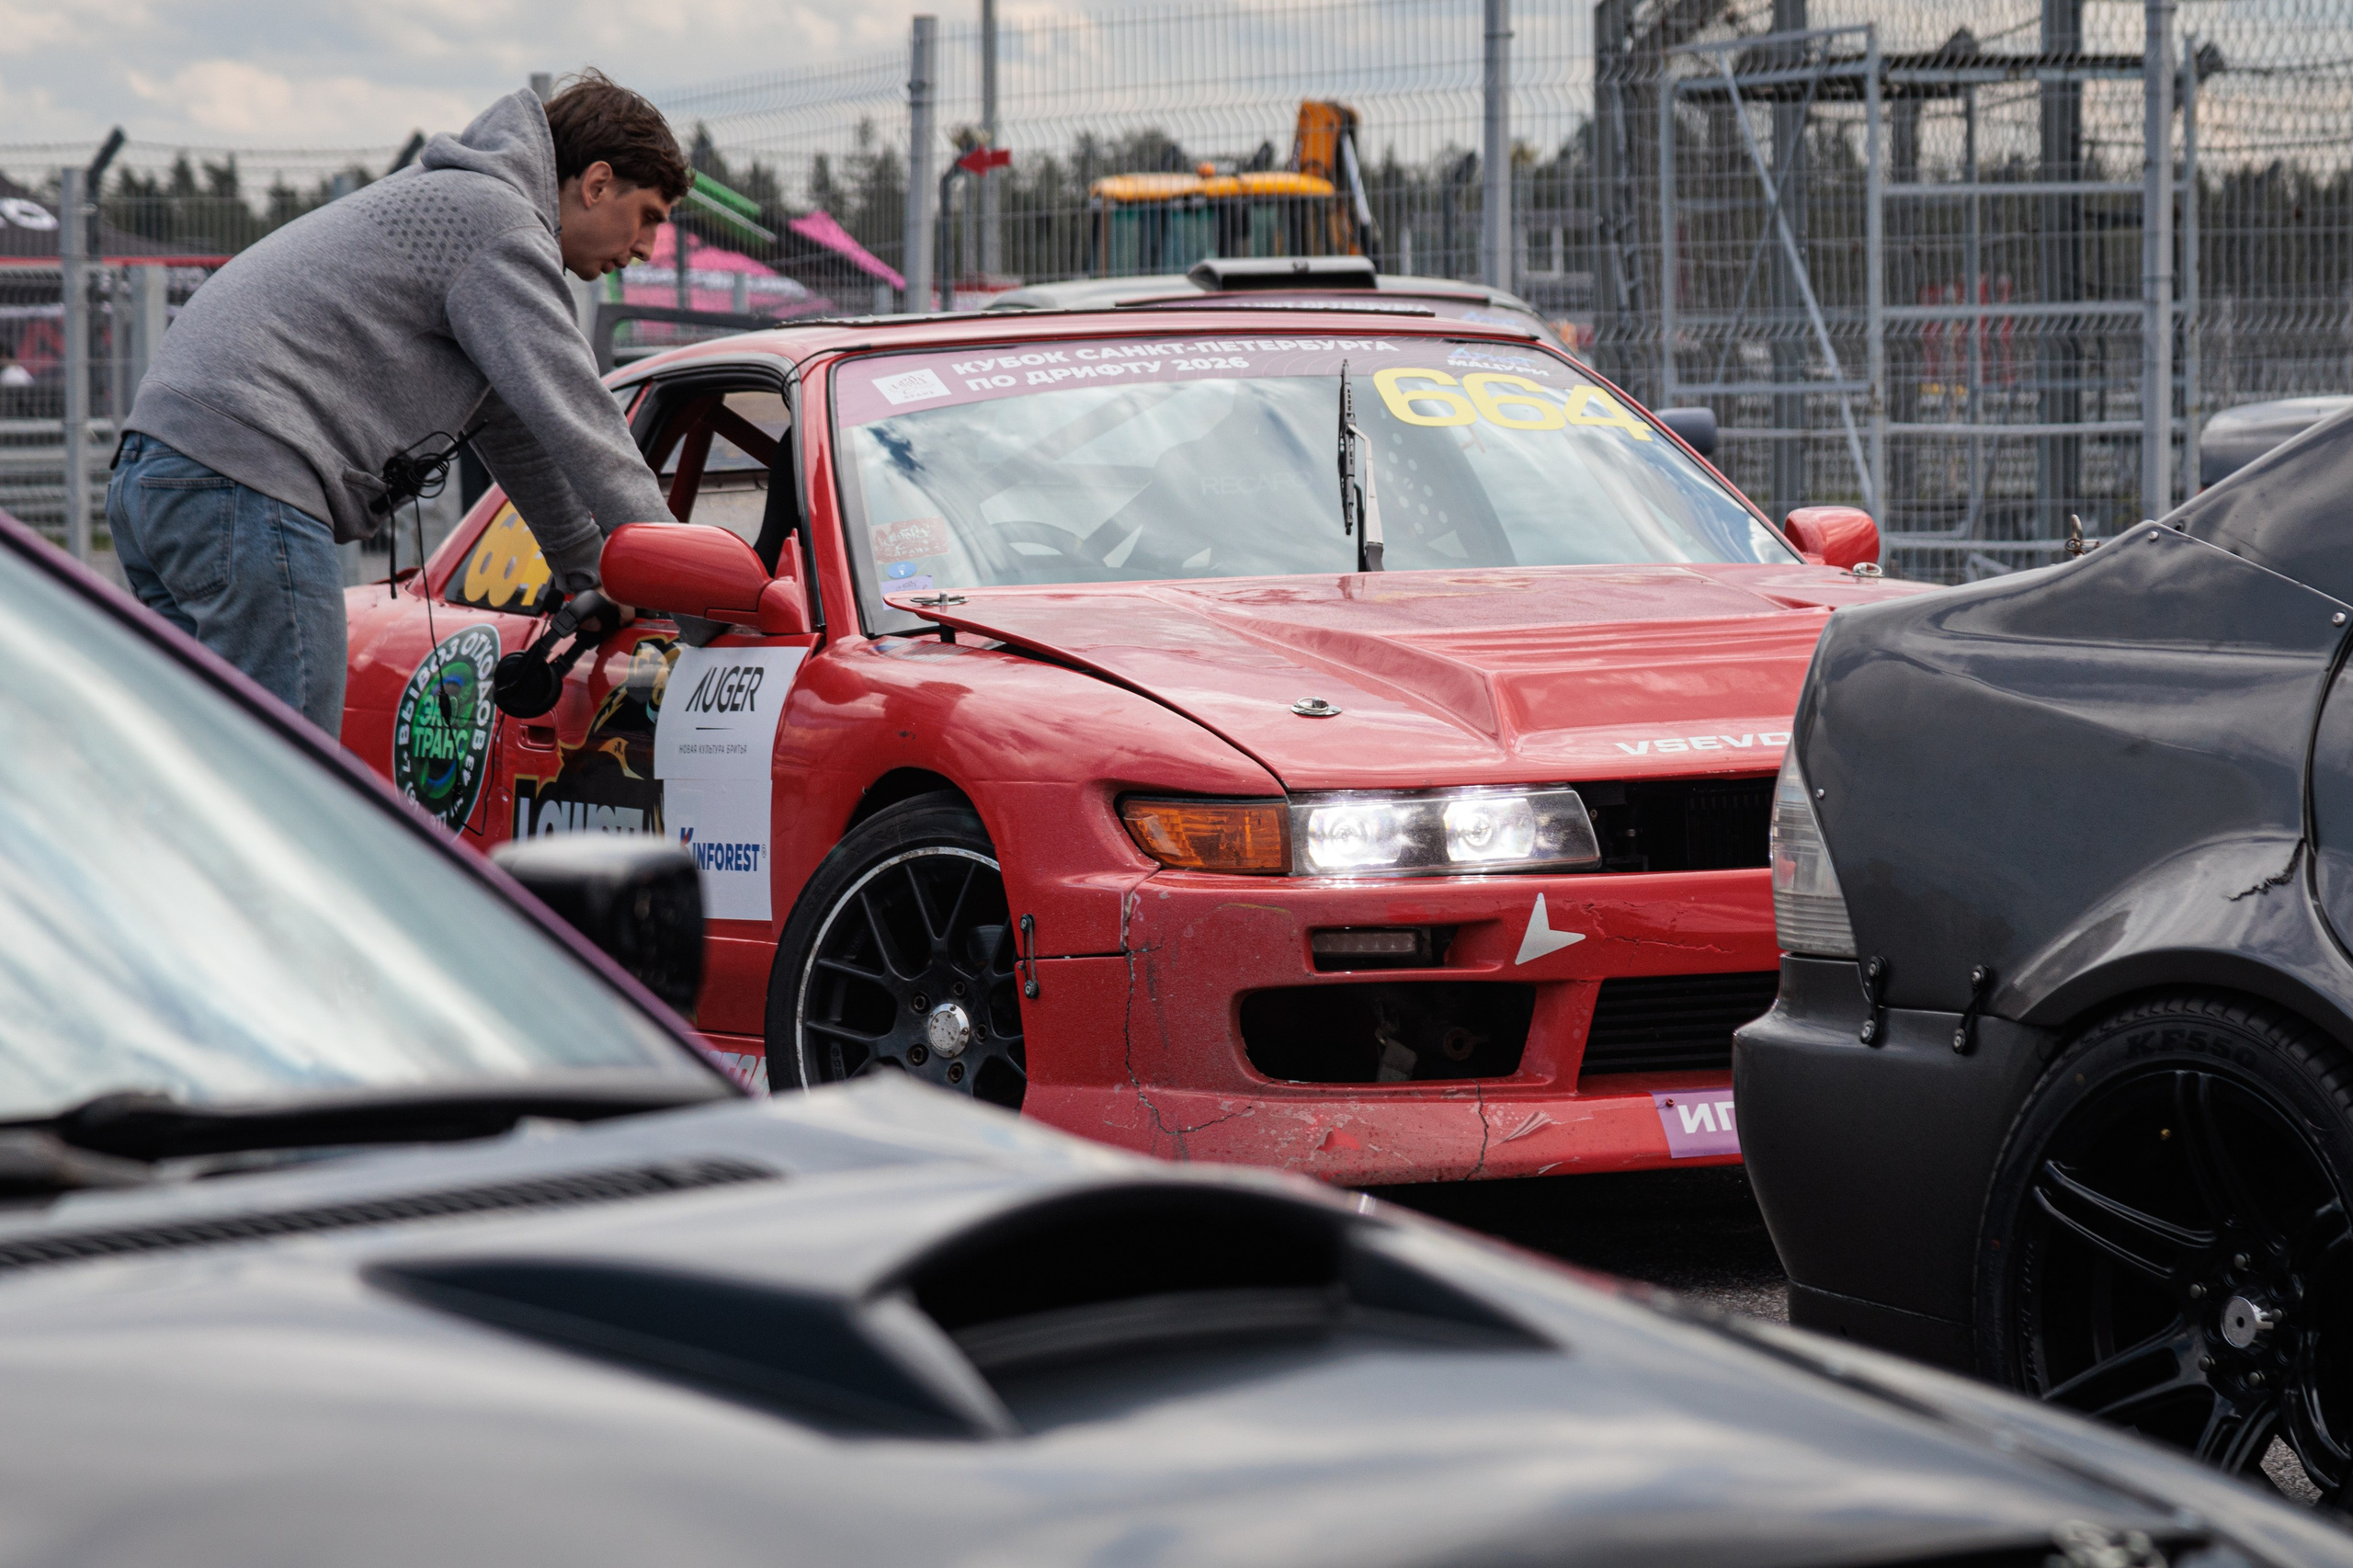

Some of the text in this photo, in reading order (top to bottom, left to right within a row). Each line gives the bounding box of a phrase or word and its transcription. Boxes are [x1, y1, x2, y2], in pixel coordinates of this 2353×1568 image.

[951, 339, 1400, 375] КУБОК САНКТ-ПЕТЕРБУРГА
[965, 356, 1250, 392] ПО ДРИФТУ 2026
[1373, 368, 1654, 441] 664
[398, 631, 494, 751] ВЫВОЗ ОТХОДОВ
[685, 665, 765, 713] AUGER
[415, 726, 469, 761] ТРАНС
[679, 744, 747, 754] НОВАЯ КУЛЬТУРА БРИТЬЯ
[2126, 1028, 2258, 1069] KF550
